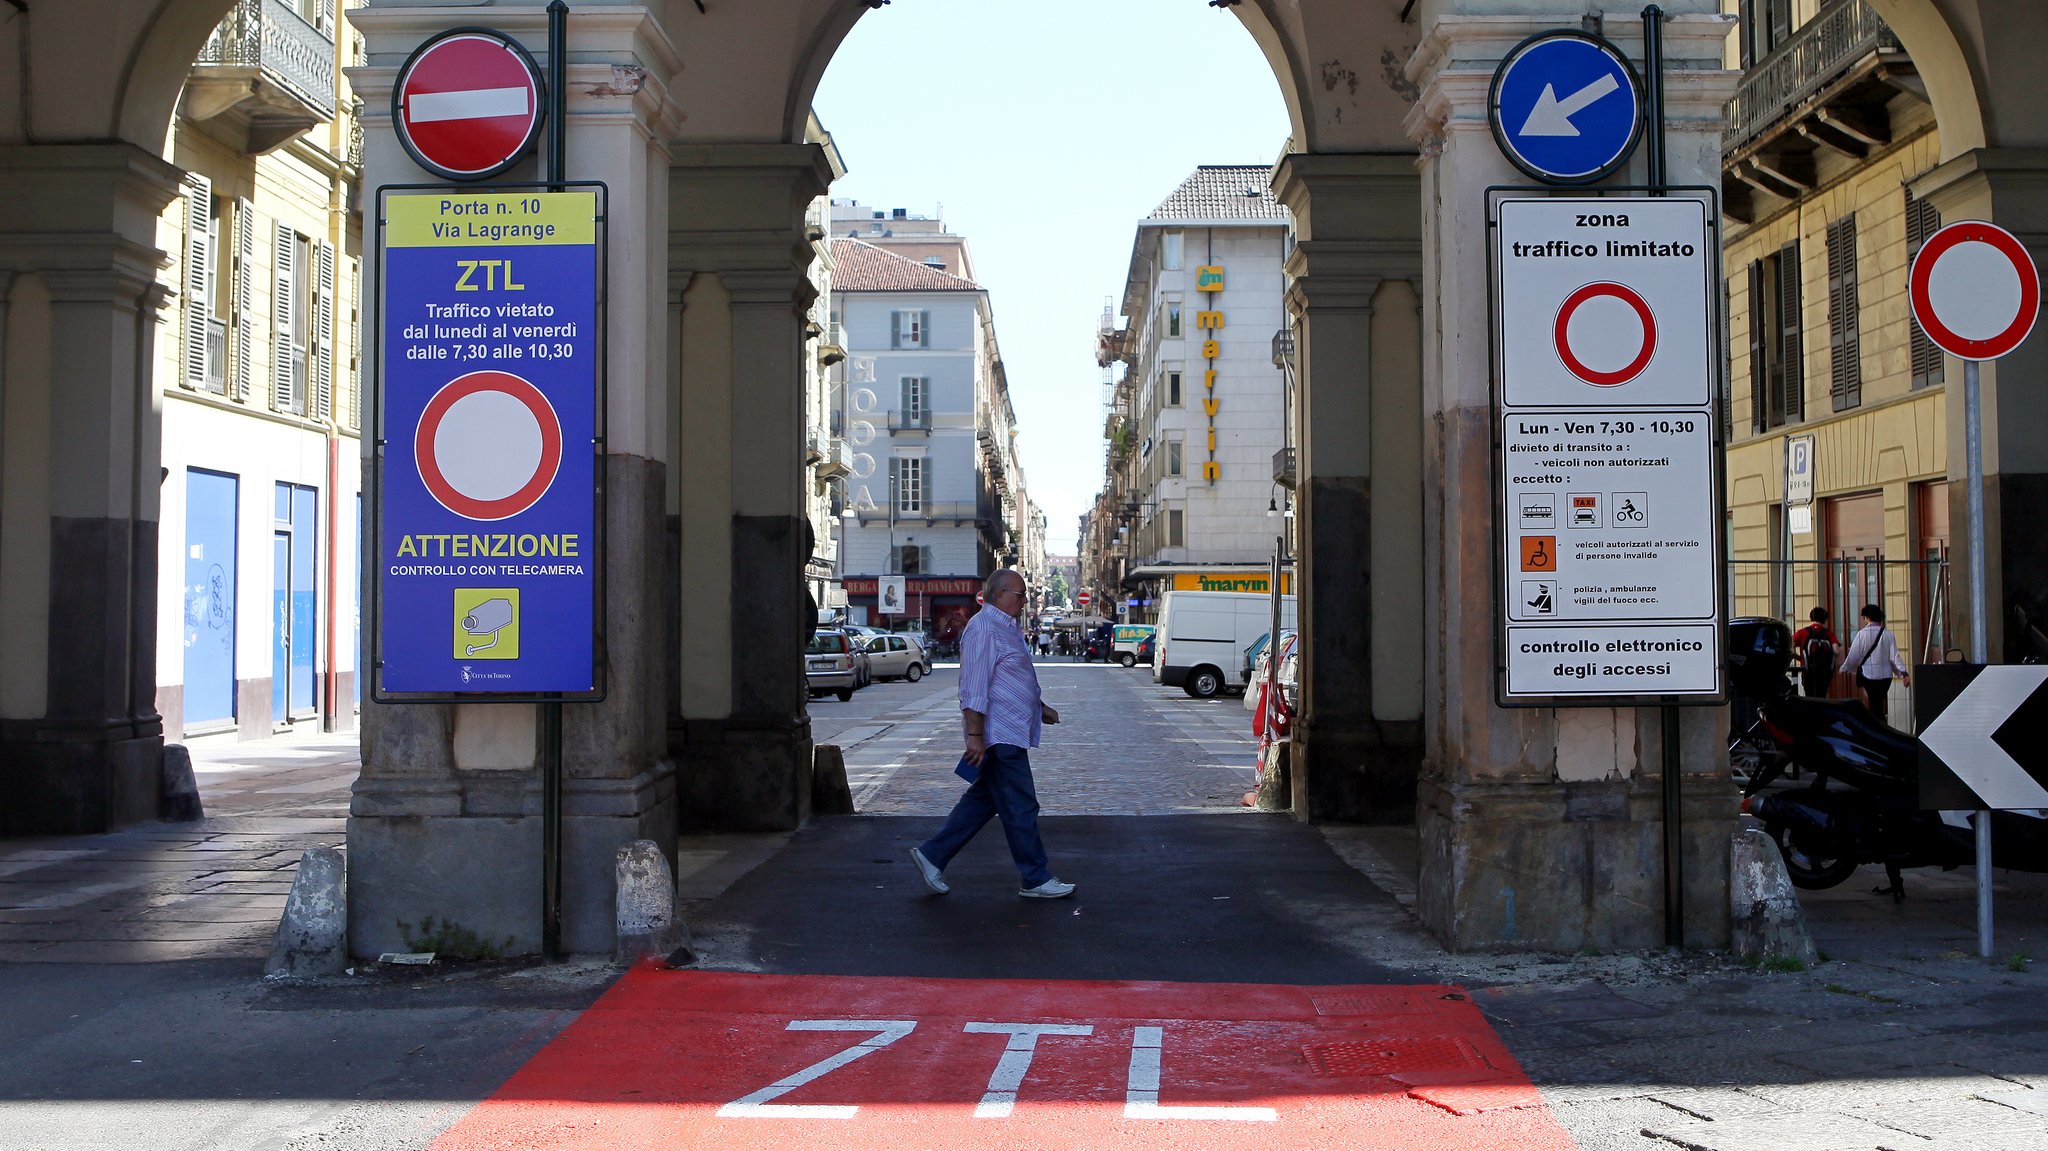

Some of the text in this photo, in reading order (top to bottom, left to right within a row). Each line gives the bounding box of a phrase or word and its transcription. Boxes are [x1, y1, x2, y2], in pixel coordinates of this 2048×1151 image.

[440, 199, 541, 216] Porta n. 10
[1575, 214, 1630, 227] zona
[432, 222, 555, 241] Via Lagrange
[1512, 240, 1695, 257] traffico limitato
[455, 259, 525, 291] ZTL
[425, 302, 555, 318] Traffico vietato
[403, 322, 577, 339] dal lunedì al venerdì
[406, 343, 573, 361] dalle 7,30 alle 10,30
[1197, 311, 1225, 480] marvin
[1519, 422, 1549, 435] Lun
[1564, 422, 1595, 434] Ven
[1600, 421, 1635, 436] 7,30
[1650, 421, 1695, 436] 10,30
[1509, 444, 1550, 453] divieto
[1553, 443, 1564, 452] di
[1567, 442, 1613, 452] transito
[1541, 459, 1580, 467] veicoli
[1608, 458, 1669, 466] autorizzati
[1797, 447, 1805, 471] P
[1513, 475, 1563, 484] eccetto
[397, 534, 579, 558] ATTENZIONE
[1606, 540, 1652, 548] autorizzati
[1575, 552, 1584, 560] di
[1586, 553, 1621, 561] persone
[390, 565, 584, 576] CONTROLLO CON TELECAMERA
[1573, 585, 1602, 594] polizia
[1574, 597, 1595, 605] vigili
[1520, 639, 1703, 653] controllo elettronico
[1553, 662, 1671, 679] degli accessi
[716, 1020, 1278, 1121] ZTL
